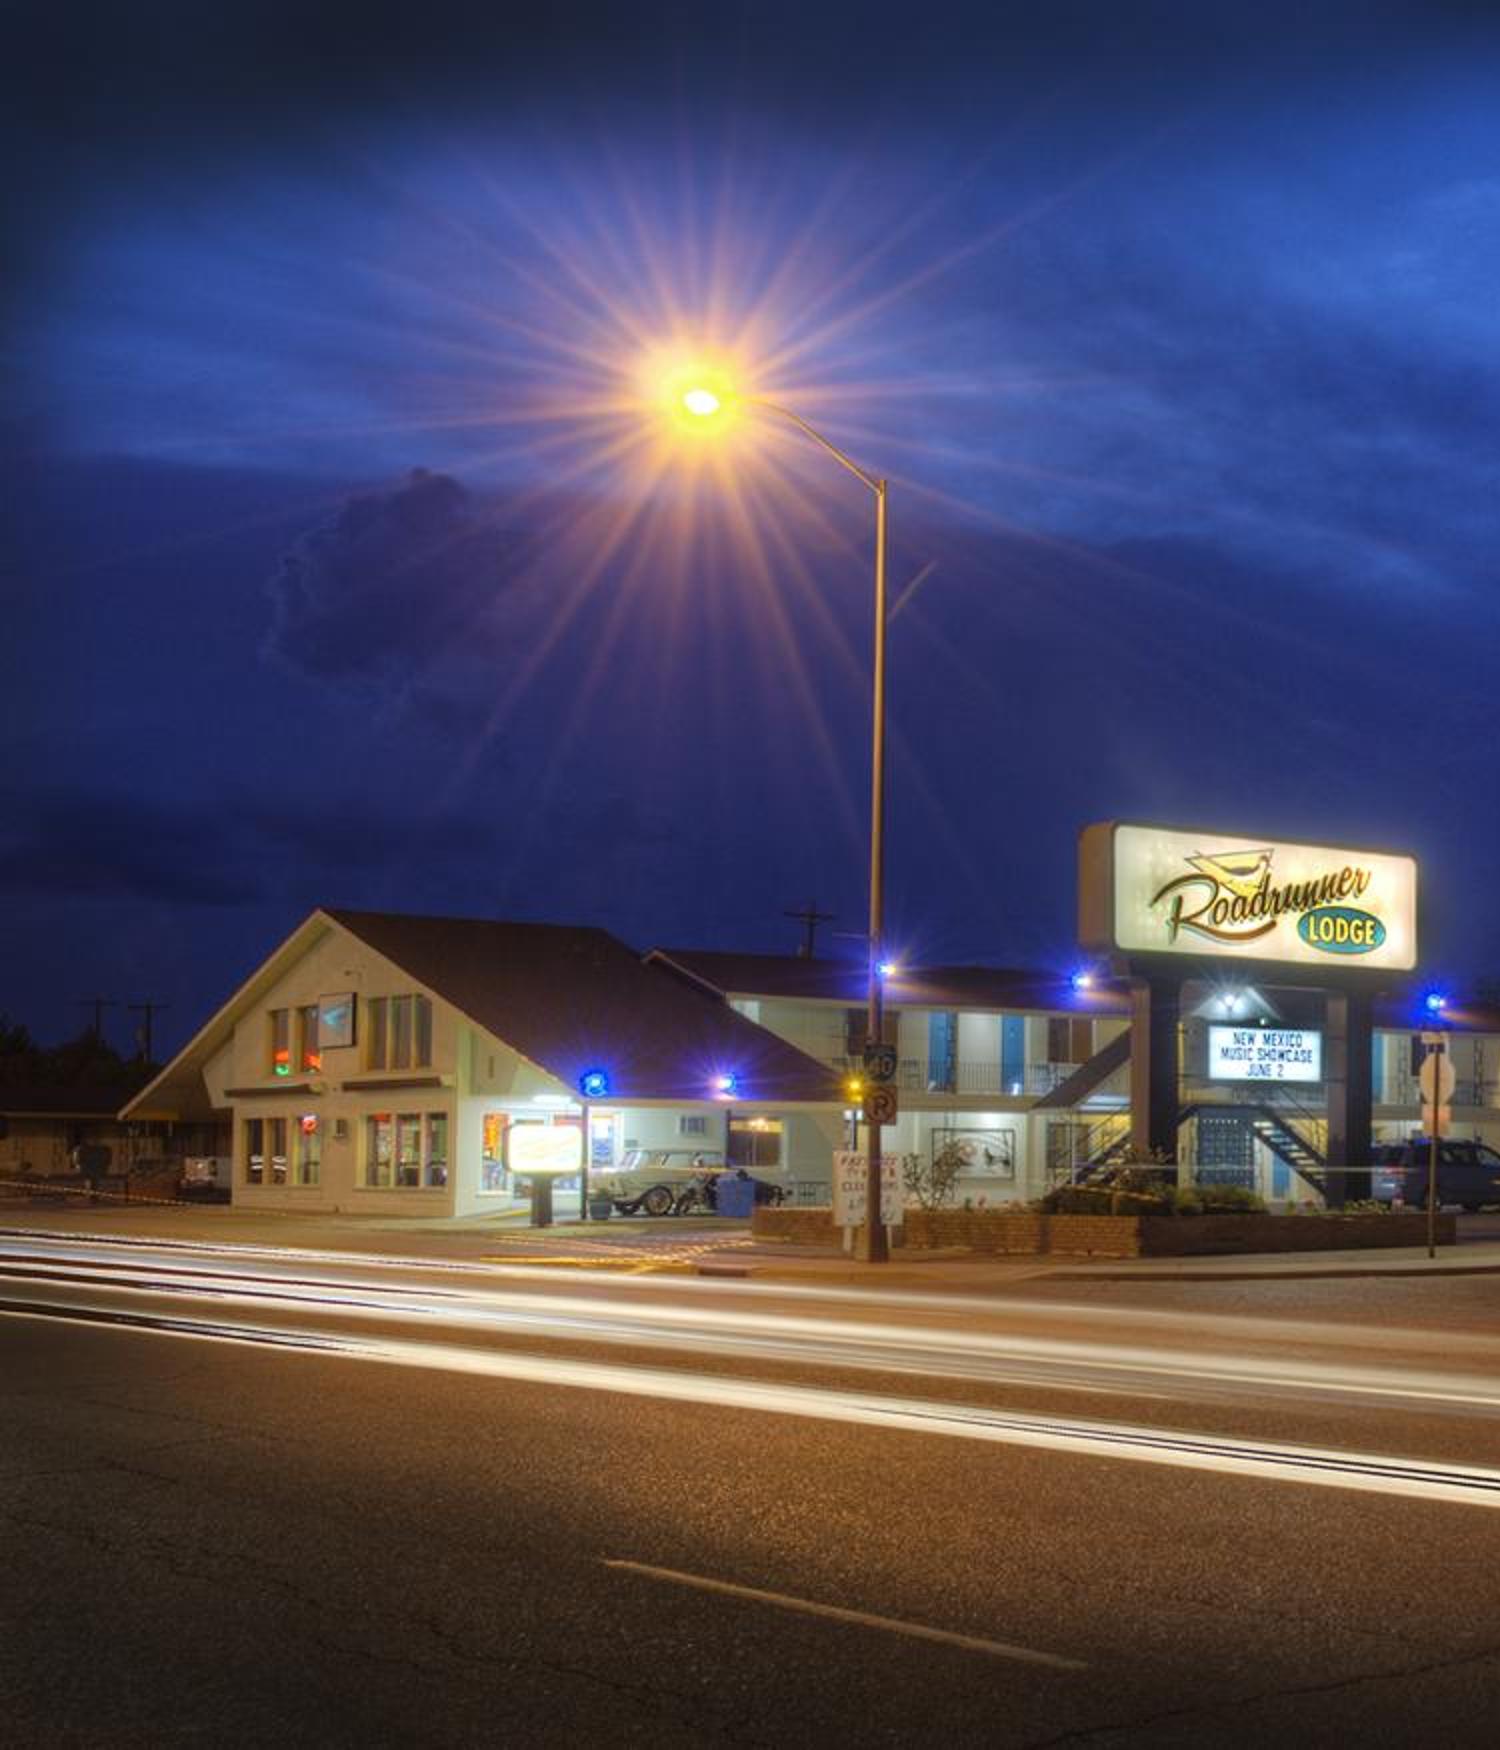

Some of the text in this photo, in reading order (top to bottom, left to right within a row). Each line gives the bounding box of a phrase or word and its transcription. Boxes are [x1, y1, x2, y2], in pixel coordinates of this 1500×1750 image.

[1149, 864, 1372, 944] Roadrunner
[1307, 914, 1377, 946] LODGE
[1233, 1031, 1303, 1049] NEW MEXICO
[1220, 1046, 1313, 1063] MUSIC SHOWCASE
[1246, 1062, 1285, 1078] JUNE 2
